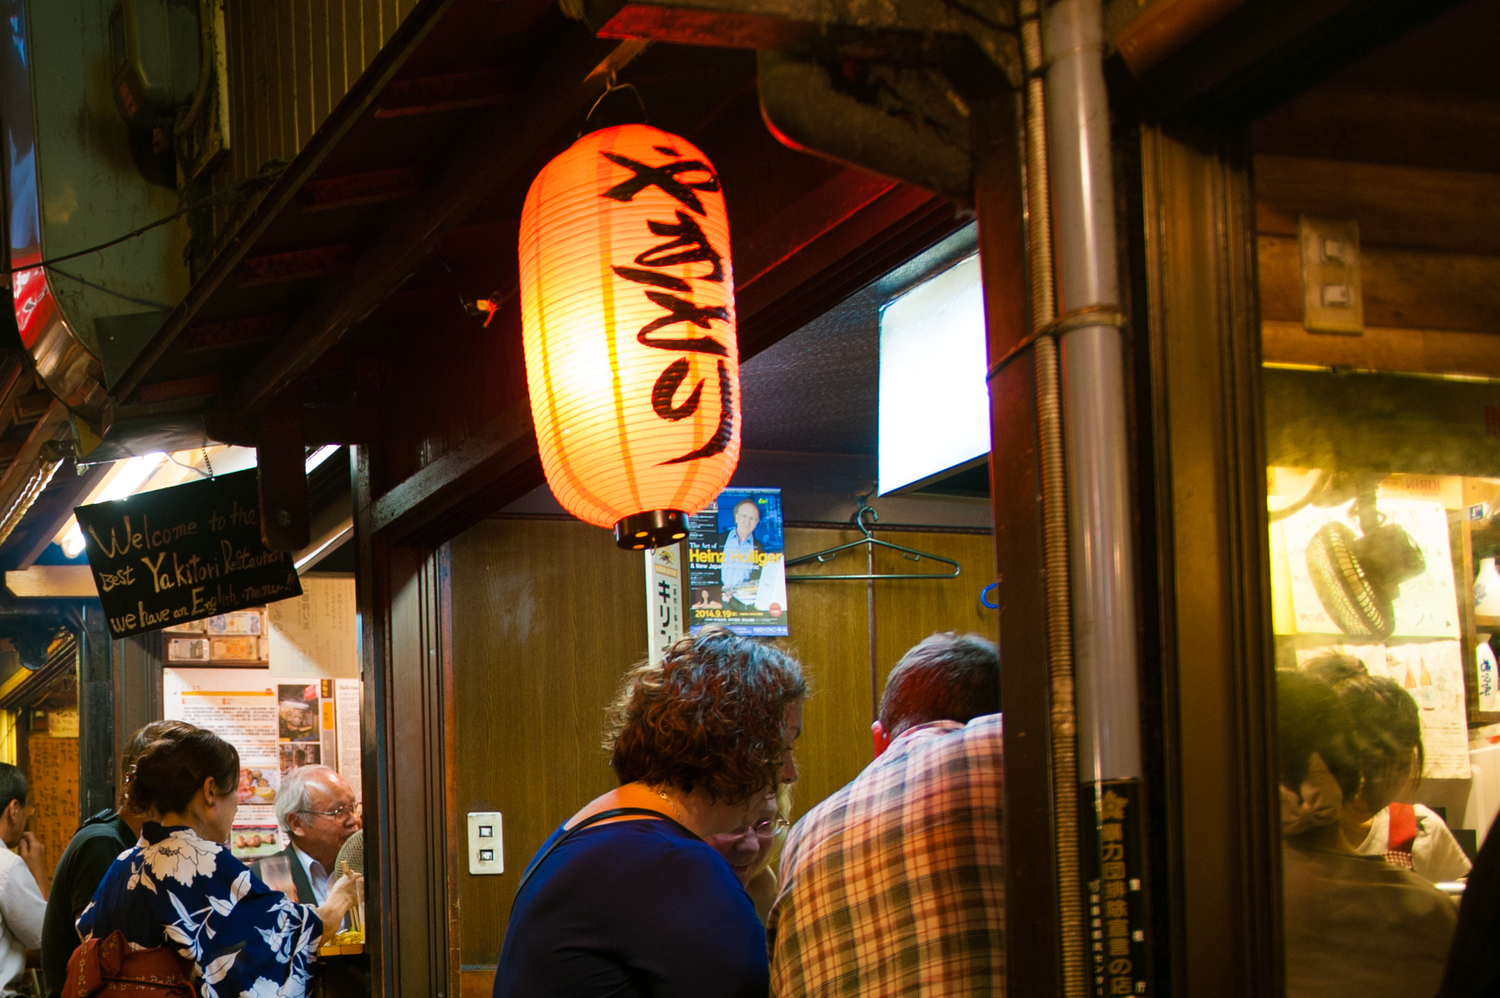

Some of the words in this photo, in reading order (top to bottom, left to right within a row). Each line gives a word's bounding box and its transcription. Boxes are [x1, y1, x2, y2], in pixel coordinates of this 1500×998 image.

[598, 145, 732, 467] やきとり
[88, 514, 198, 559] Welcome
[208, 510, 226, 532] to
[230, 501, 256, 526] the
[141, 551, 220, 593] Yakitori
[689, 549, 726, 563] Heinz
[730, 550, 784, 566] Holliger
[110, 612, 137, 634] we
[138, 601, 170, 628] have
[173, 606, 189, 619] an
[191, 586, 237, 615] English
[694, 609, 731, 618] 2014.9.19
